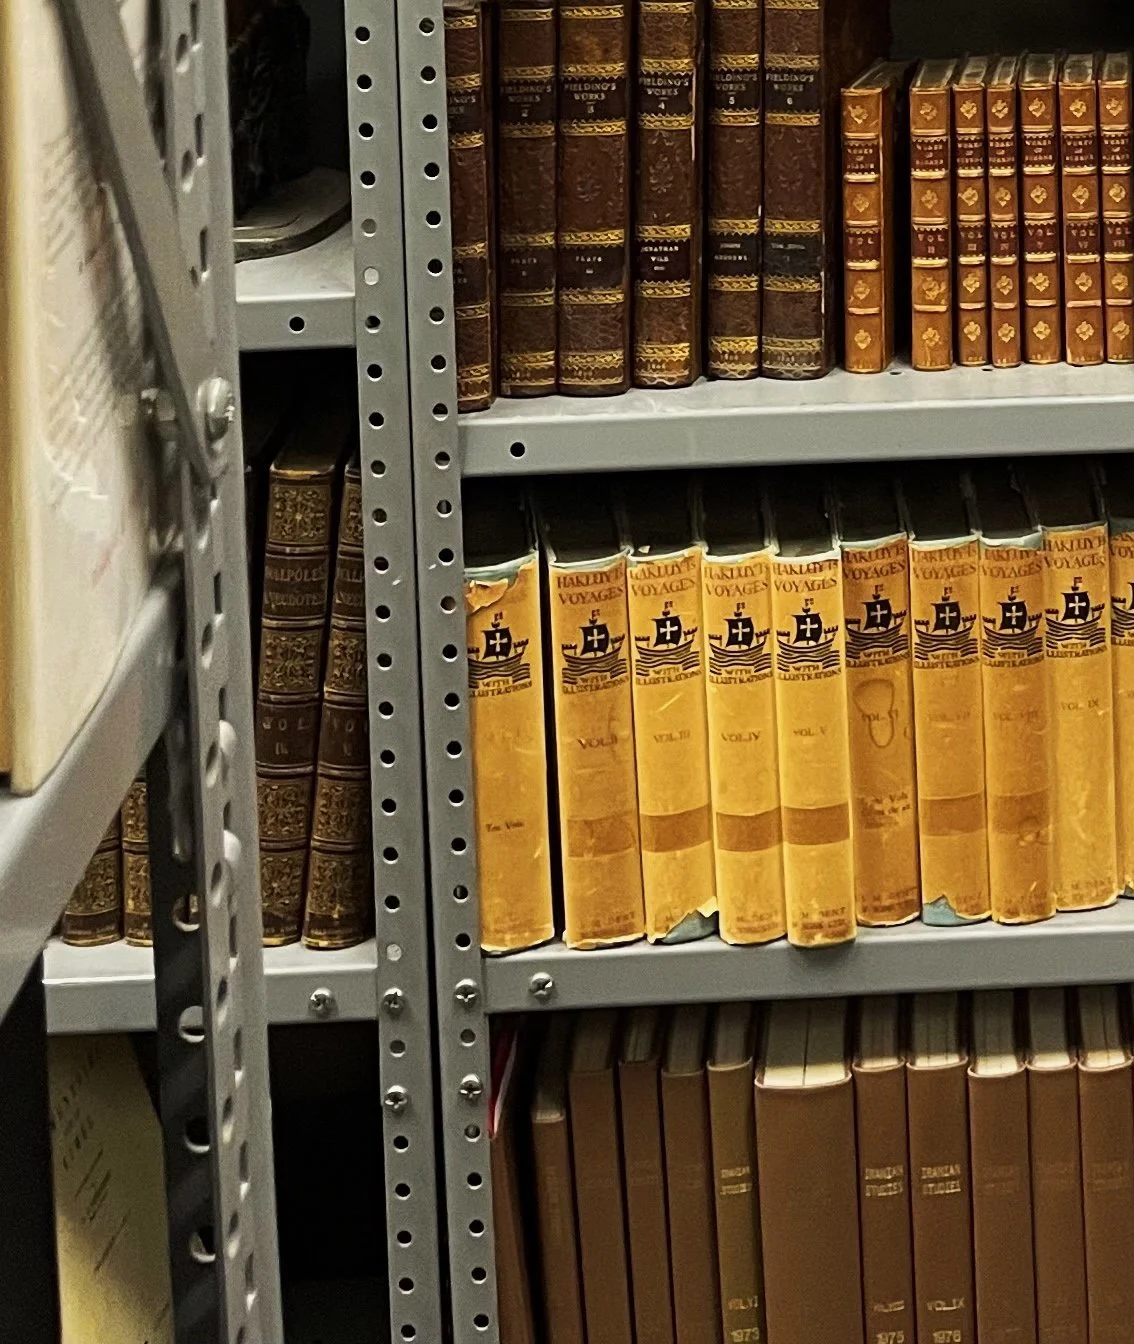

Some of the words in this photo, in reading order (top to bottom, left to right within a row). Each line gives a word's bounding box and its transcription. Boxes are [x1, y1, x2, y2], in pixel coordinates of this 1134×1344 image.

[658, 100, 665, 110] 4
[728, 96, 735, 105] 5
[786, 96, 793, 105] 6
[842, 562, 906, 582] VOYAGES
[913, 564, 977, 581] VOYAGES
[982, 562, 1042, 579] VOYAGES
[631, 577, 696, 598] VOYAGES
[705, 581, 768, 598] VOYAGES
[774, 578, 837, 594] VOYAGES
[558, 586, 624, 604] VOYAGES
[1060, 640, 1087, 650] WITH
[862, 649, 890, 660] WITH
[930, 651, 958, 662] WITH
[652, 667, 681, 676] WITH
[723, 668, 751, 677] WITH
[791, 664, 820, 673] WITH
[482, 679, 510, 688] WITH
[579, 675, 607, 684] WITH
[921, 1164, 961, 1178] IRANIAN
[923, 1180, 961, 1195] STUDIES
[731, 1327, 760, 1342] 1973
[876, 1330, 905, 1344] 1975
